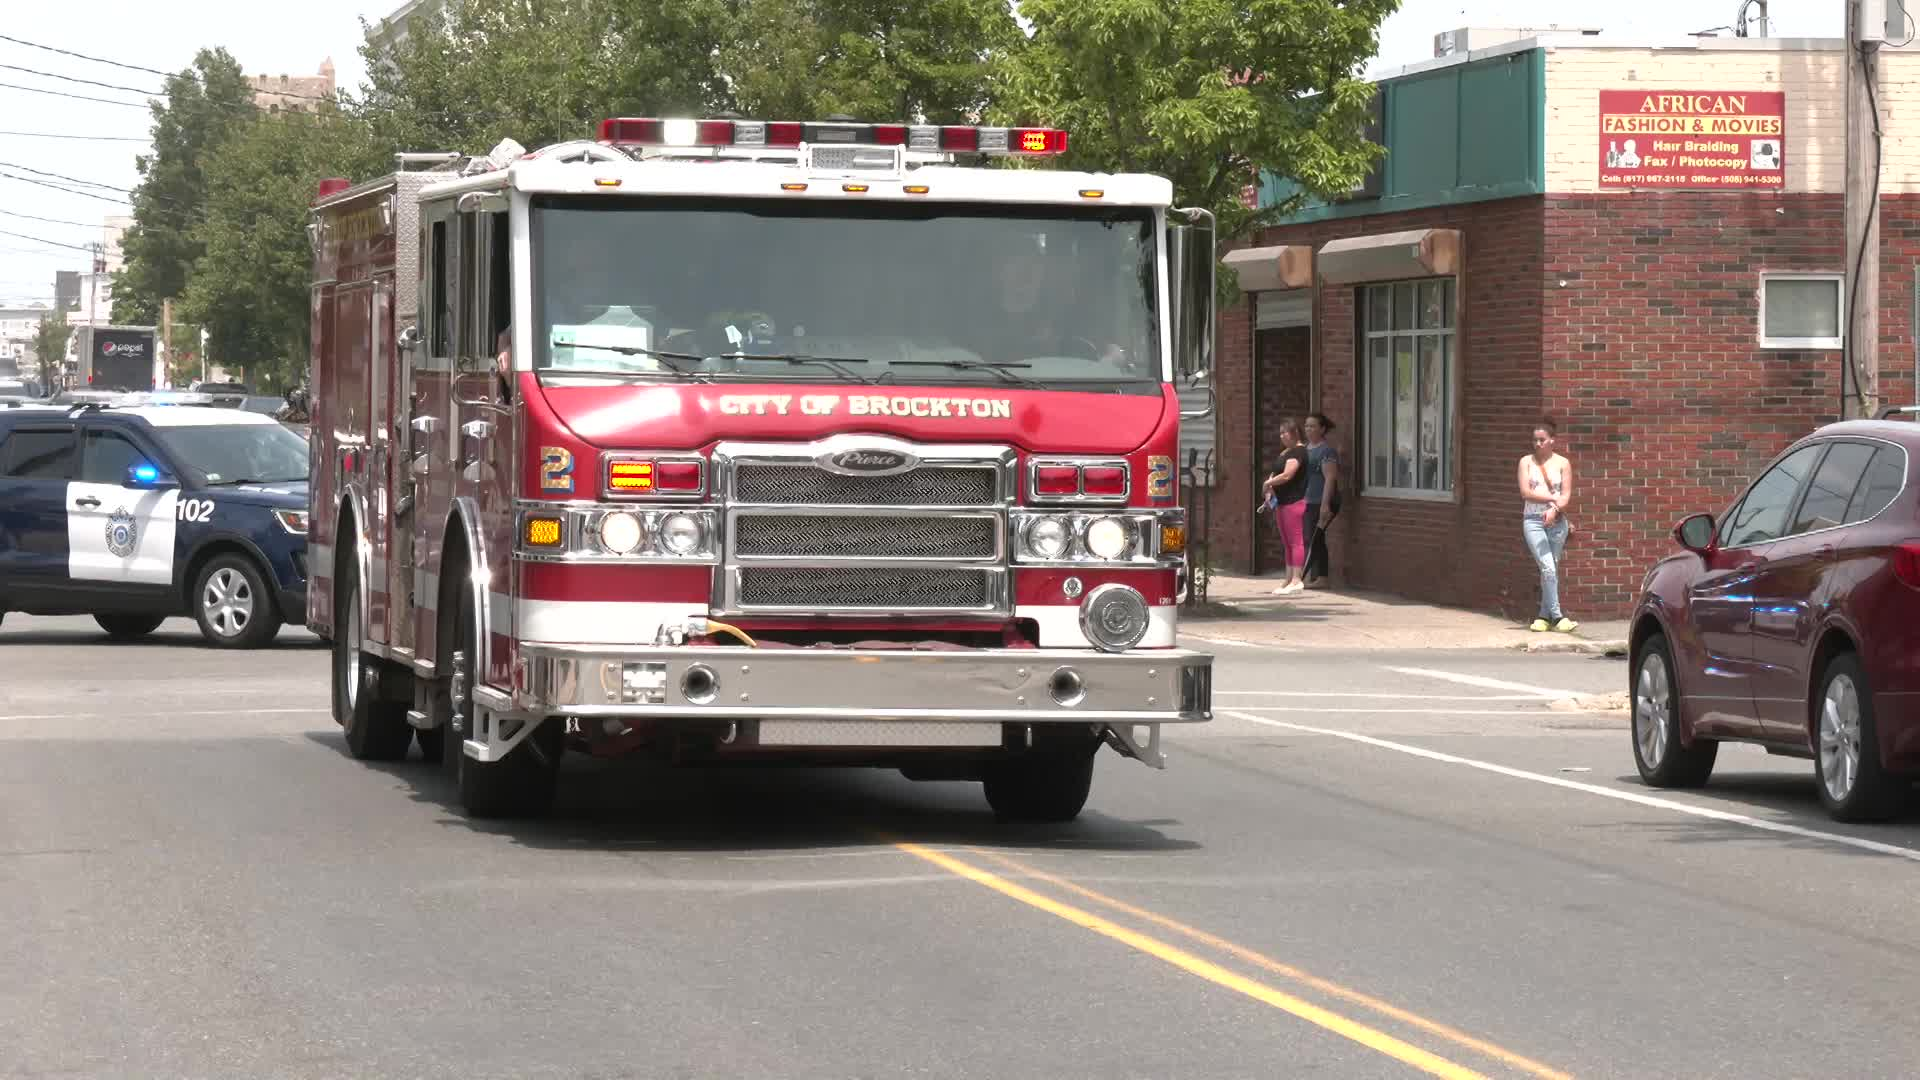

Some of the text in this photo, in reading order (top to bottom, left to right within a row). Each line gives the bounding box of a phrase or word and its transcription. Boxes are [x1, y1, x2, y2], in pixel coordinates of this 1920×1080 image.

[1640, 95, 1746, 113] AFRICAN
[1604, 118, 1780, 133] FASHION & MOVIES
[1653, 140, 1739, 154] Hair Braiding
[1644, 156, 1668, 167] Fax
[1679, 156, 1748, 170] Photocopy
[719, 395, 1011, 418] CITY OF BROCKTON
[839, 452, 896, 466] Pierce
[540, 446, 575, 494] 2
[1147, 455, 1175, 500] 2
[177, 499, 215, 522] 102
